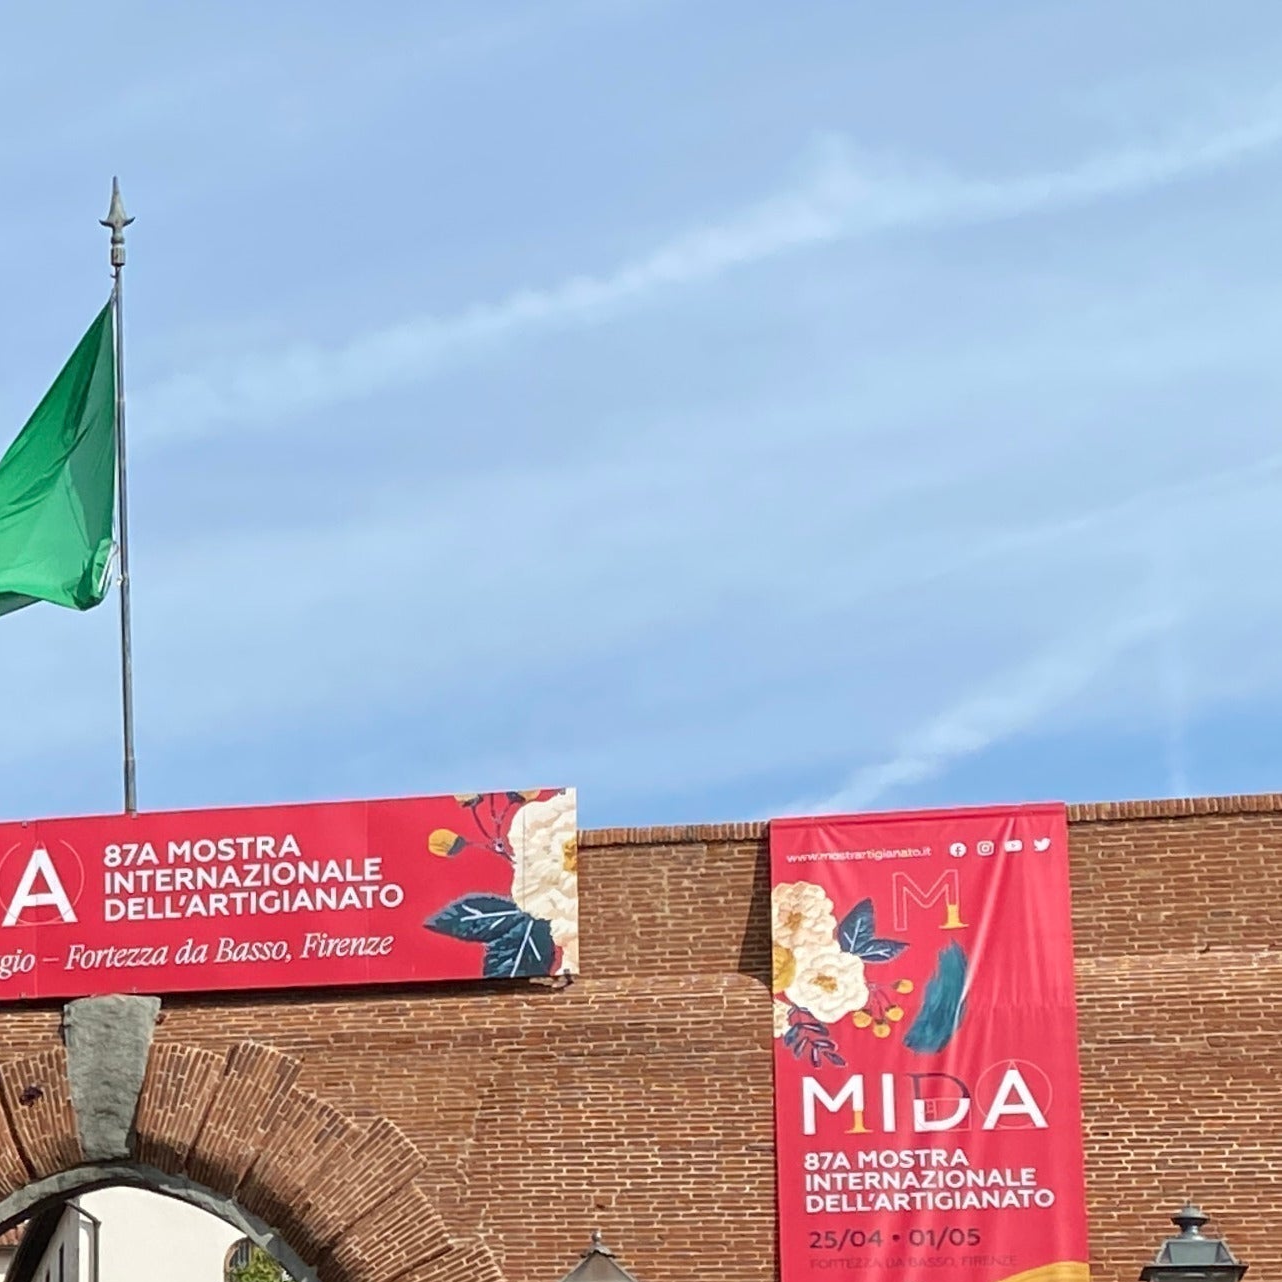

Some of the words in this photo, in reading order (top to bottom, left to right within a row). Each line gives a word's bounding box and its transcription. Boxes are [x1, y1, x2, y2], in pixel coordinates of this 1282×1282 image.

[103, 844, 158, 867] 87A
[167, 835, 301, 864] MOSTRA
[103, 857, 384, 895] INTERNAZIONALE
[104, 883, 406, 922] DELL'ARTIGIANATO
[64, 943, 168, 970] Fortezza
[174, 939, 208, 966] da
[212, 936, 293, 964] Basso,
[299, 932, 395, 959] Firenze
[801, 1068, 1050, 1136] MIDA
[804, 1151, 852, 1171] 87A
[857, 1148, 970, 1169] MOSTRA
[805, 1167, 1038, 1192] INTERNAZIONALE
[805, 1188, 1056, 1214] DELL'ARTIGIANATO
[808, 1229, 884, 1251] 25/04
[908, 1227, 982, 1250] 01/05
